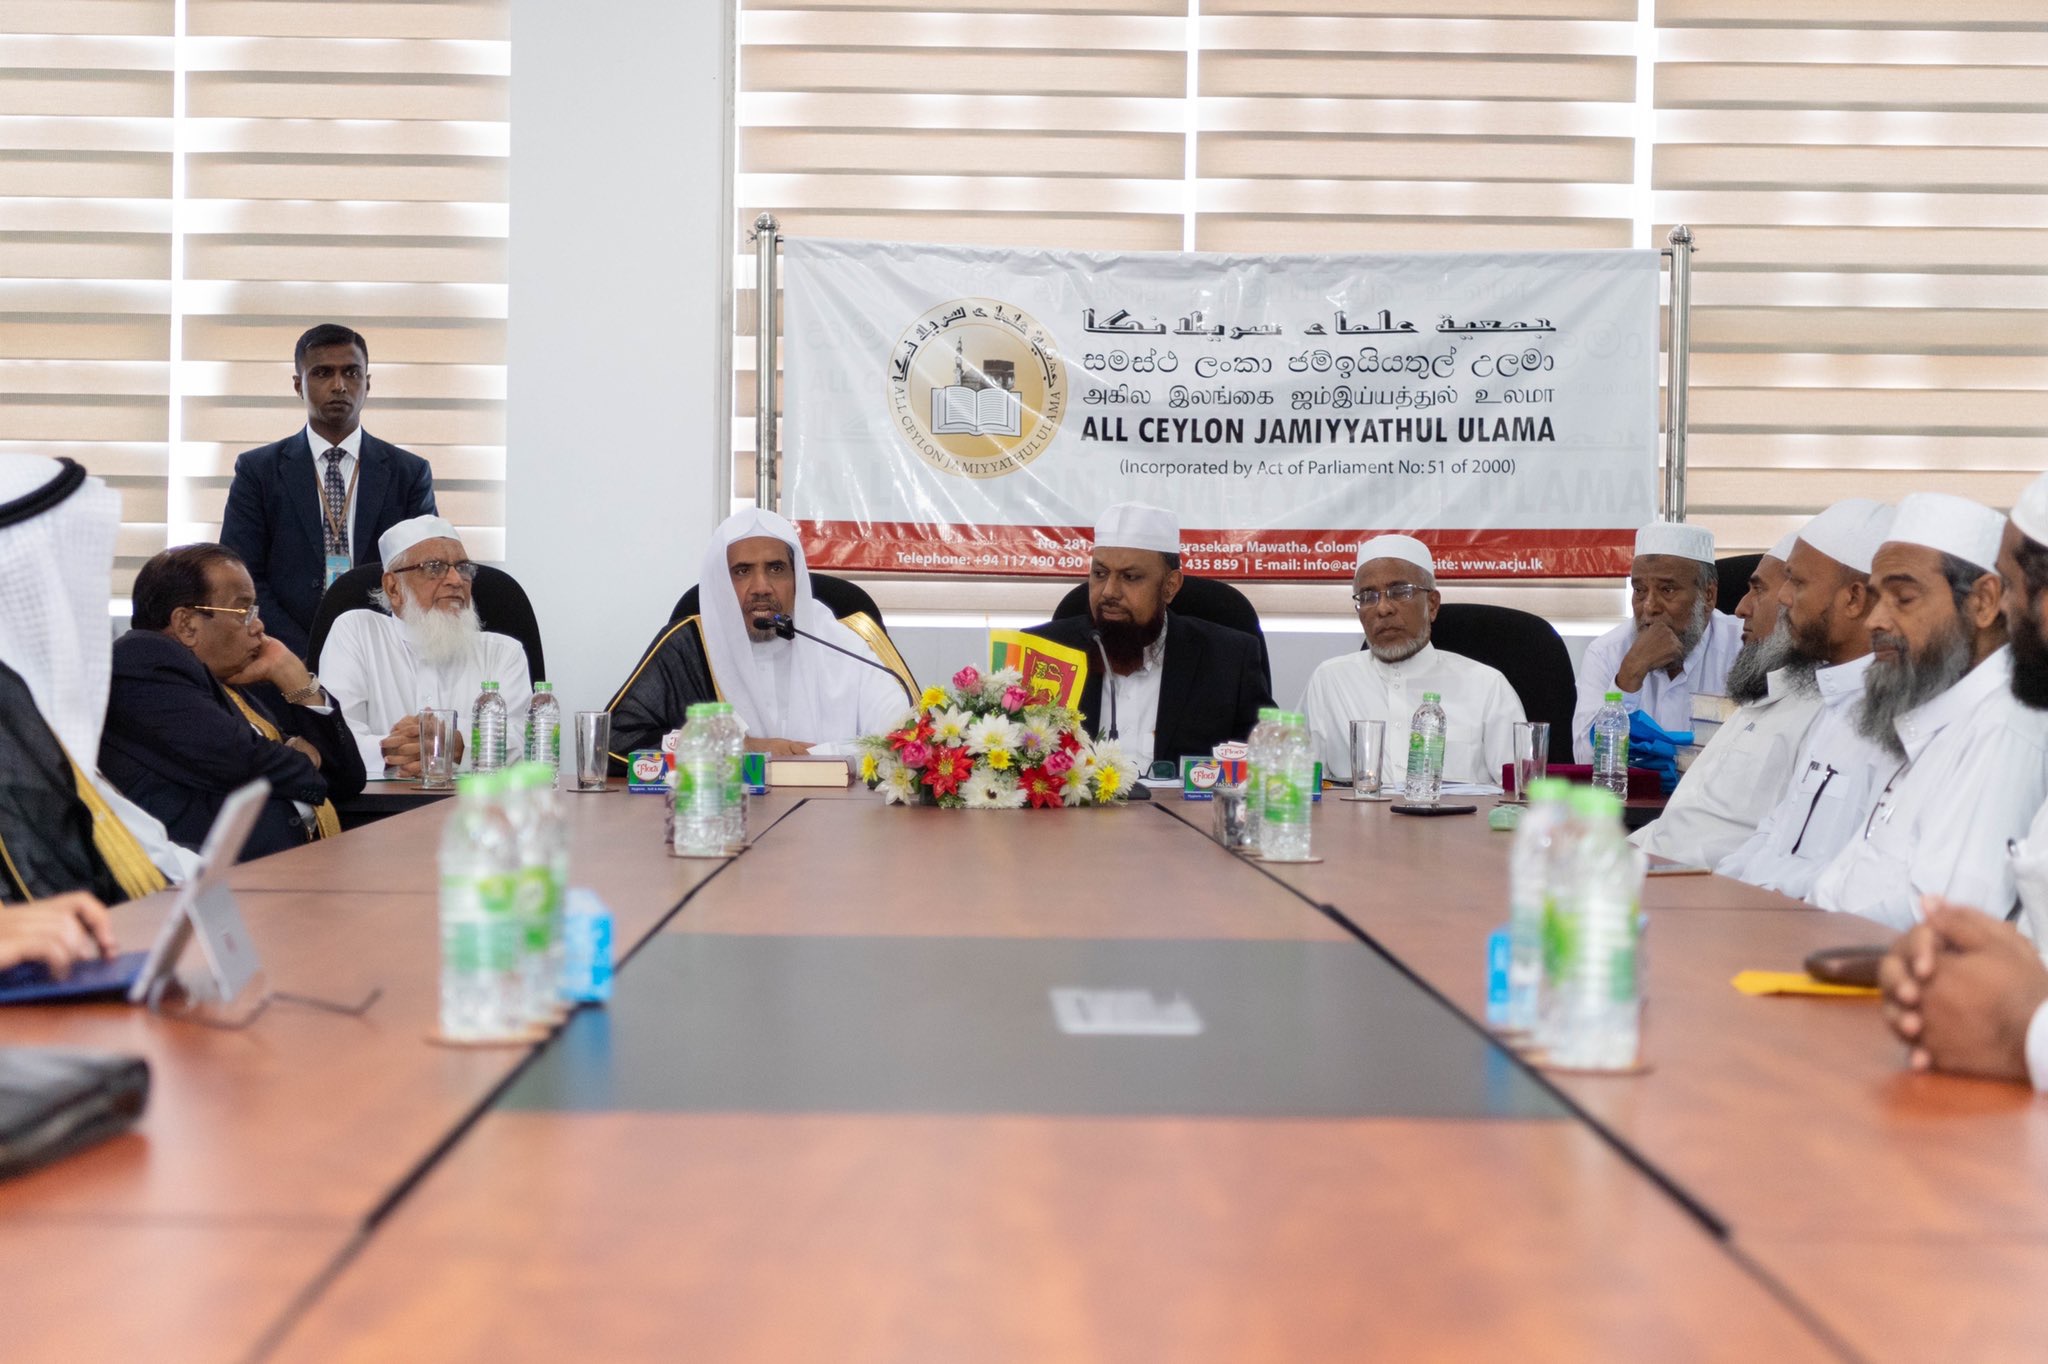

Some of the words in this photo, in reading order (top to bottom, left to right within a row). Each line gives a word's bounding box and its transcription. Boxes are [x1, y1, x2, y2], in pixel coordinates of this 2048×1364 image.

[1304, 309, 1420, 335] علماء
[1435, 313, 1557, 340] جمعية
[1195, 356, 1273, 379] ලංකා
[1471, 348, 1554, 378] උලමා
[1083, 383, 1152, 405] அகில
[1168, 385, 1274, 409] இலங்கை
[1475, 388, 1555, 404] உலமா
[894, 386, 906, 414] ALL
[902, 415, 946, 463] CEYLON
[1041, 391, 1062, 440] ULAMA
[1081, 416, 1128, 442] ALL
[1139, 417, 1244, 444] CEYLON
[1254, 416, 1447, 444] JAMIYYATHUL
[1458, 415, 1556, 443] ULAMA
[1120, 459, 1229, 478] (Incorporated
[1233, 460, 1253, 479] by
[1257, 460, 1284, 475] Act
[1288, 459, 1305, 475] of
[1309, 459, 1394, 475] Parliament
[1451, 459, 1469, 475] of
[1472, 459, 1516, 476] 2000)
[1180, 540, 1243, 553] erasekara
[1246, 540, 1312, 555] Mawatha,
[896, 551, 971, 567] Telephone:
[974, 555, 999, 567] +94
[1003, 555, 1027, 567] 117
[1031, 555, 1055, 568] 490
[1058, 556, 1084, 568] 490
[1185, 558, 1210, 571] 435
[1213, 558, 1239, 571] 859
[1255, 558, 1301, 571] E-mail:
[1303, 558, 1357, 573] info@ac
[1432, 557, 1459, 571] site:
[1462, 558, 1544, 573] www.acju.lk
